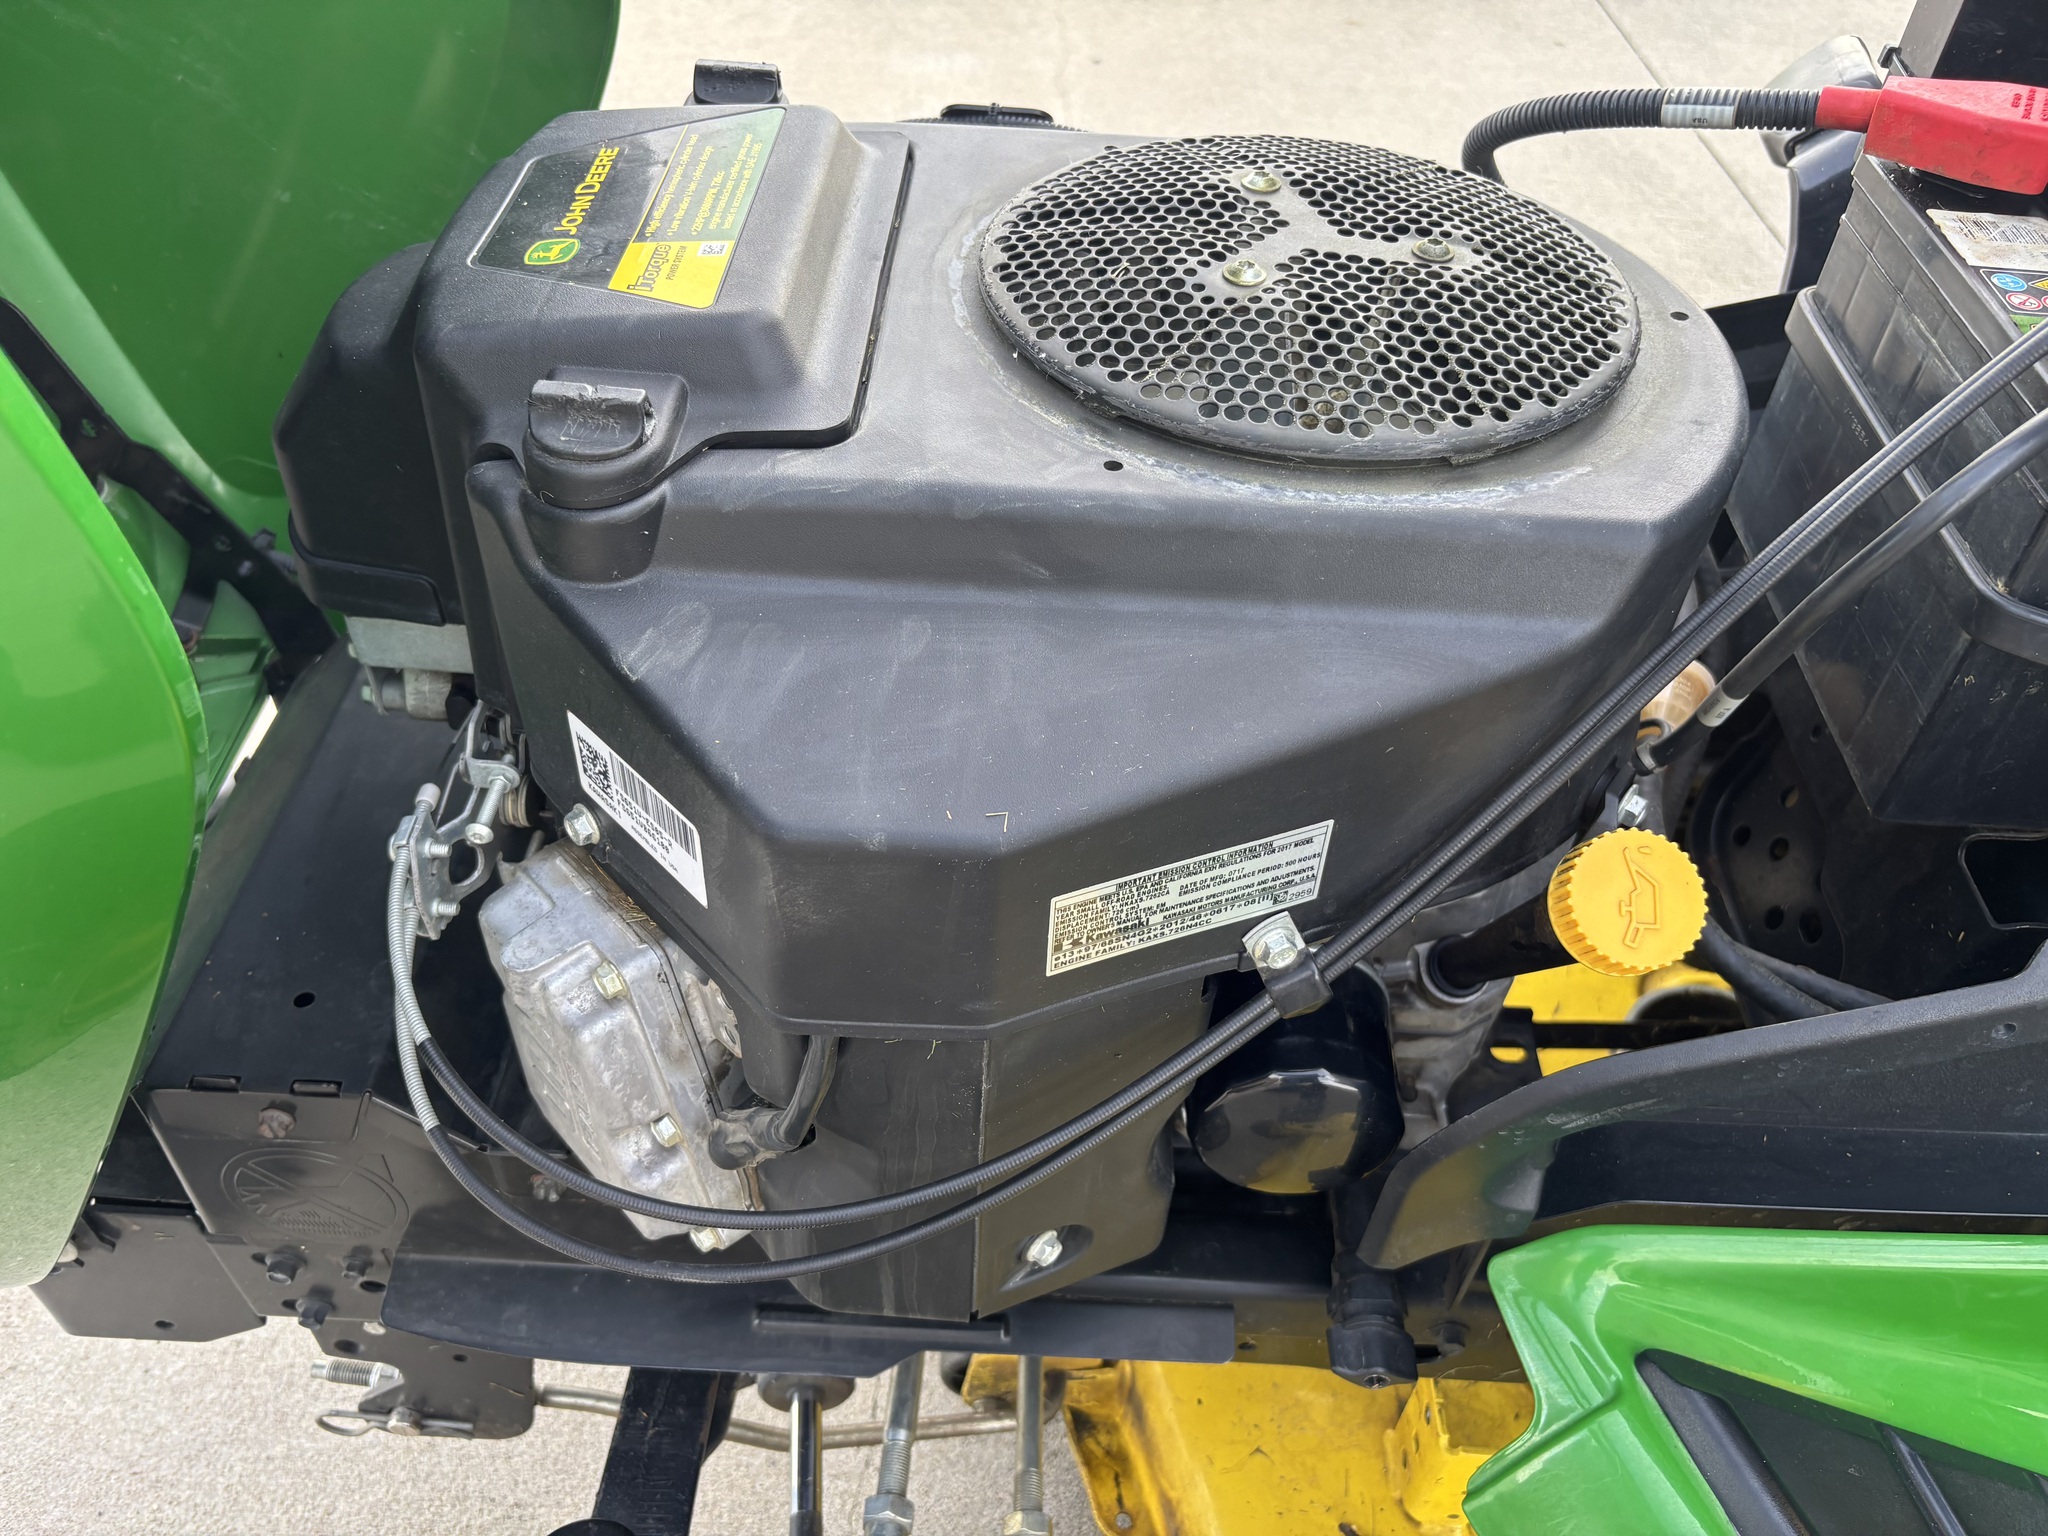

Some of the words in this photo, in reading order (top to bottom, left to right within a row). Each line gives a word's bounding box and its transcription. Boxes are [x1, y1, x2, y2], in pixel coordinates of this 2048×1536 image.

[686, 134, 699, 145] head
[741, 133, 755, 147] power
[678, 145, 696, 164] cylinder
[699, 145, 715, 160] design
[737, 147, 749, 159] gross
[745, 157, 757, 168] SAE
[664, 164, 687, 193] hemispheric
[690, 161, 709, 180] cylinder
[727, 160, 742, 179] certified
[741, 169, 752, 178] with
[554, 196, 589, 235] JOHN
[575, 146, 620, 194] DEERE
[714, 180, 734, 211] manufacturer
[730, 179, 749, 207] accordance
[652, 194, 674, 218] efficiency
[673, 196, 691, 219] vibration
[645, 220, 662, 231] High
[667, 220, 680, 230] Low
[707, 212, 723, 228] engine
[721, 213, 735, 228] tested
[626, 244, 670, 291] iTorque
[665, 263, 679, 280] POWER
[673, 245, 687, 262] SYSTEM
[587, 780, 621, 819] KAWASAKI
[1056, 905, 1071, 914] THIS
[1073, 898, 1096, 909] ENGINE
[1099, 891, 1120, 902] MEETS
[1135, 884, 1147, 892] EPA
[1149, 880, 1163, 888] AND
[1164, 868, 1202, 884] CALIFORNIA
[1218, 852, 1261, 869] REGULATIONS
[1263, 848, 1276, 856] FOR
[1277, 843, 1291, 852] 2017
[1293, 837, 1314, 847] MODEL
[1115, 873, 1156, 891] IMPORTANT
[1158, 864, 1190, 879] EMISSION
[1192, 854, 1225, 869] CONTROL
[1226, 840, 1273, 860] INFORMATION
[1178, 883, 1210, 897] EMISSION
[1212, 870, 1255, 887] COMPLIANCE
[1256, 862, 1283, 875] PERIOD:
[1284, 858, 1296, 867] 500
[1297, 851, 1321, 863] HOURS
[1179, 880, 1197, 891] DATE
[1199, 877, 1208, 885] OF
[1209, 872, 1226, 882] MFG:
[1228, 867, 1244, 877] 0717
[1162, 906, 1195, 920] KAWASAKI
[1197, 899, 1222, 910] MOTORS
[1224, 883, 1277, 903] MANUFACTURING
[1288, 887, 1312, 900] 2959
[1054, 933, 1073, 944] REFER
[1086, 922, 1114, 935] OWNER'S
[1116, 914, 1142, 926] MANUAL
[1145, 909, 1157, 918] FOR
[1158, 896, 1203, 914] MAINTENANCE
[1205, 882, 1254, 901] SPECIFICATIONS
[1256, 878, 1269, 886] AND
[1055, 912, 1088, 926] EMISSION
[1090, 904, 1117, 916] FAMILY:
[1055, 912, 1110, 932] DISPLACEMENT:
[1125, 903, 1139, 912] cm3
[1056, 911, 1073, 920] YEAR
[1076, 903, 1098, 914] SMALL
[1101, 893, 1134, 908] OFF-ROAD
[1055, 924, 1087, 938] EMISSION
[1090, 914, 1123, 928] CONTROL
[1125, 905, 1154, 918] SYSTEM:
[1156, 901, 1165, 909] EM
[1085, 917, 1149, 943] Kawasaki
[1053, 952, 1092, 968] ENGINE
[1095, 939, 1135, 956] FAMILY:
